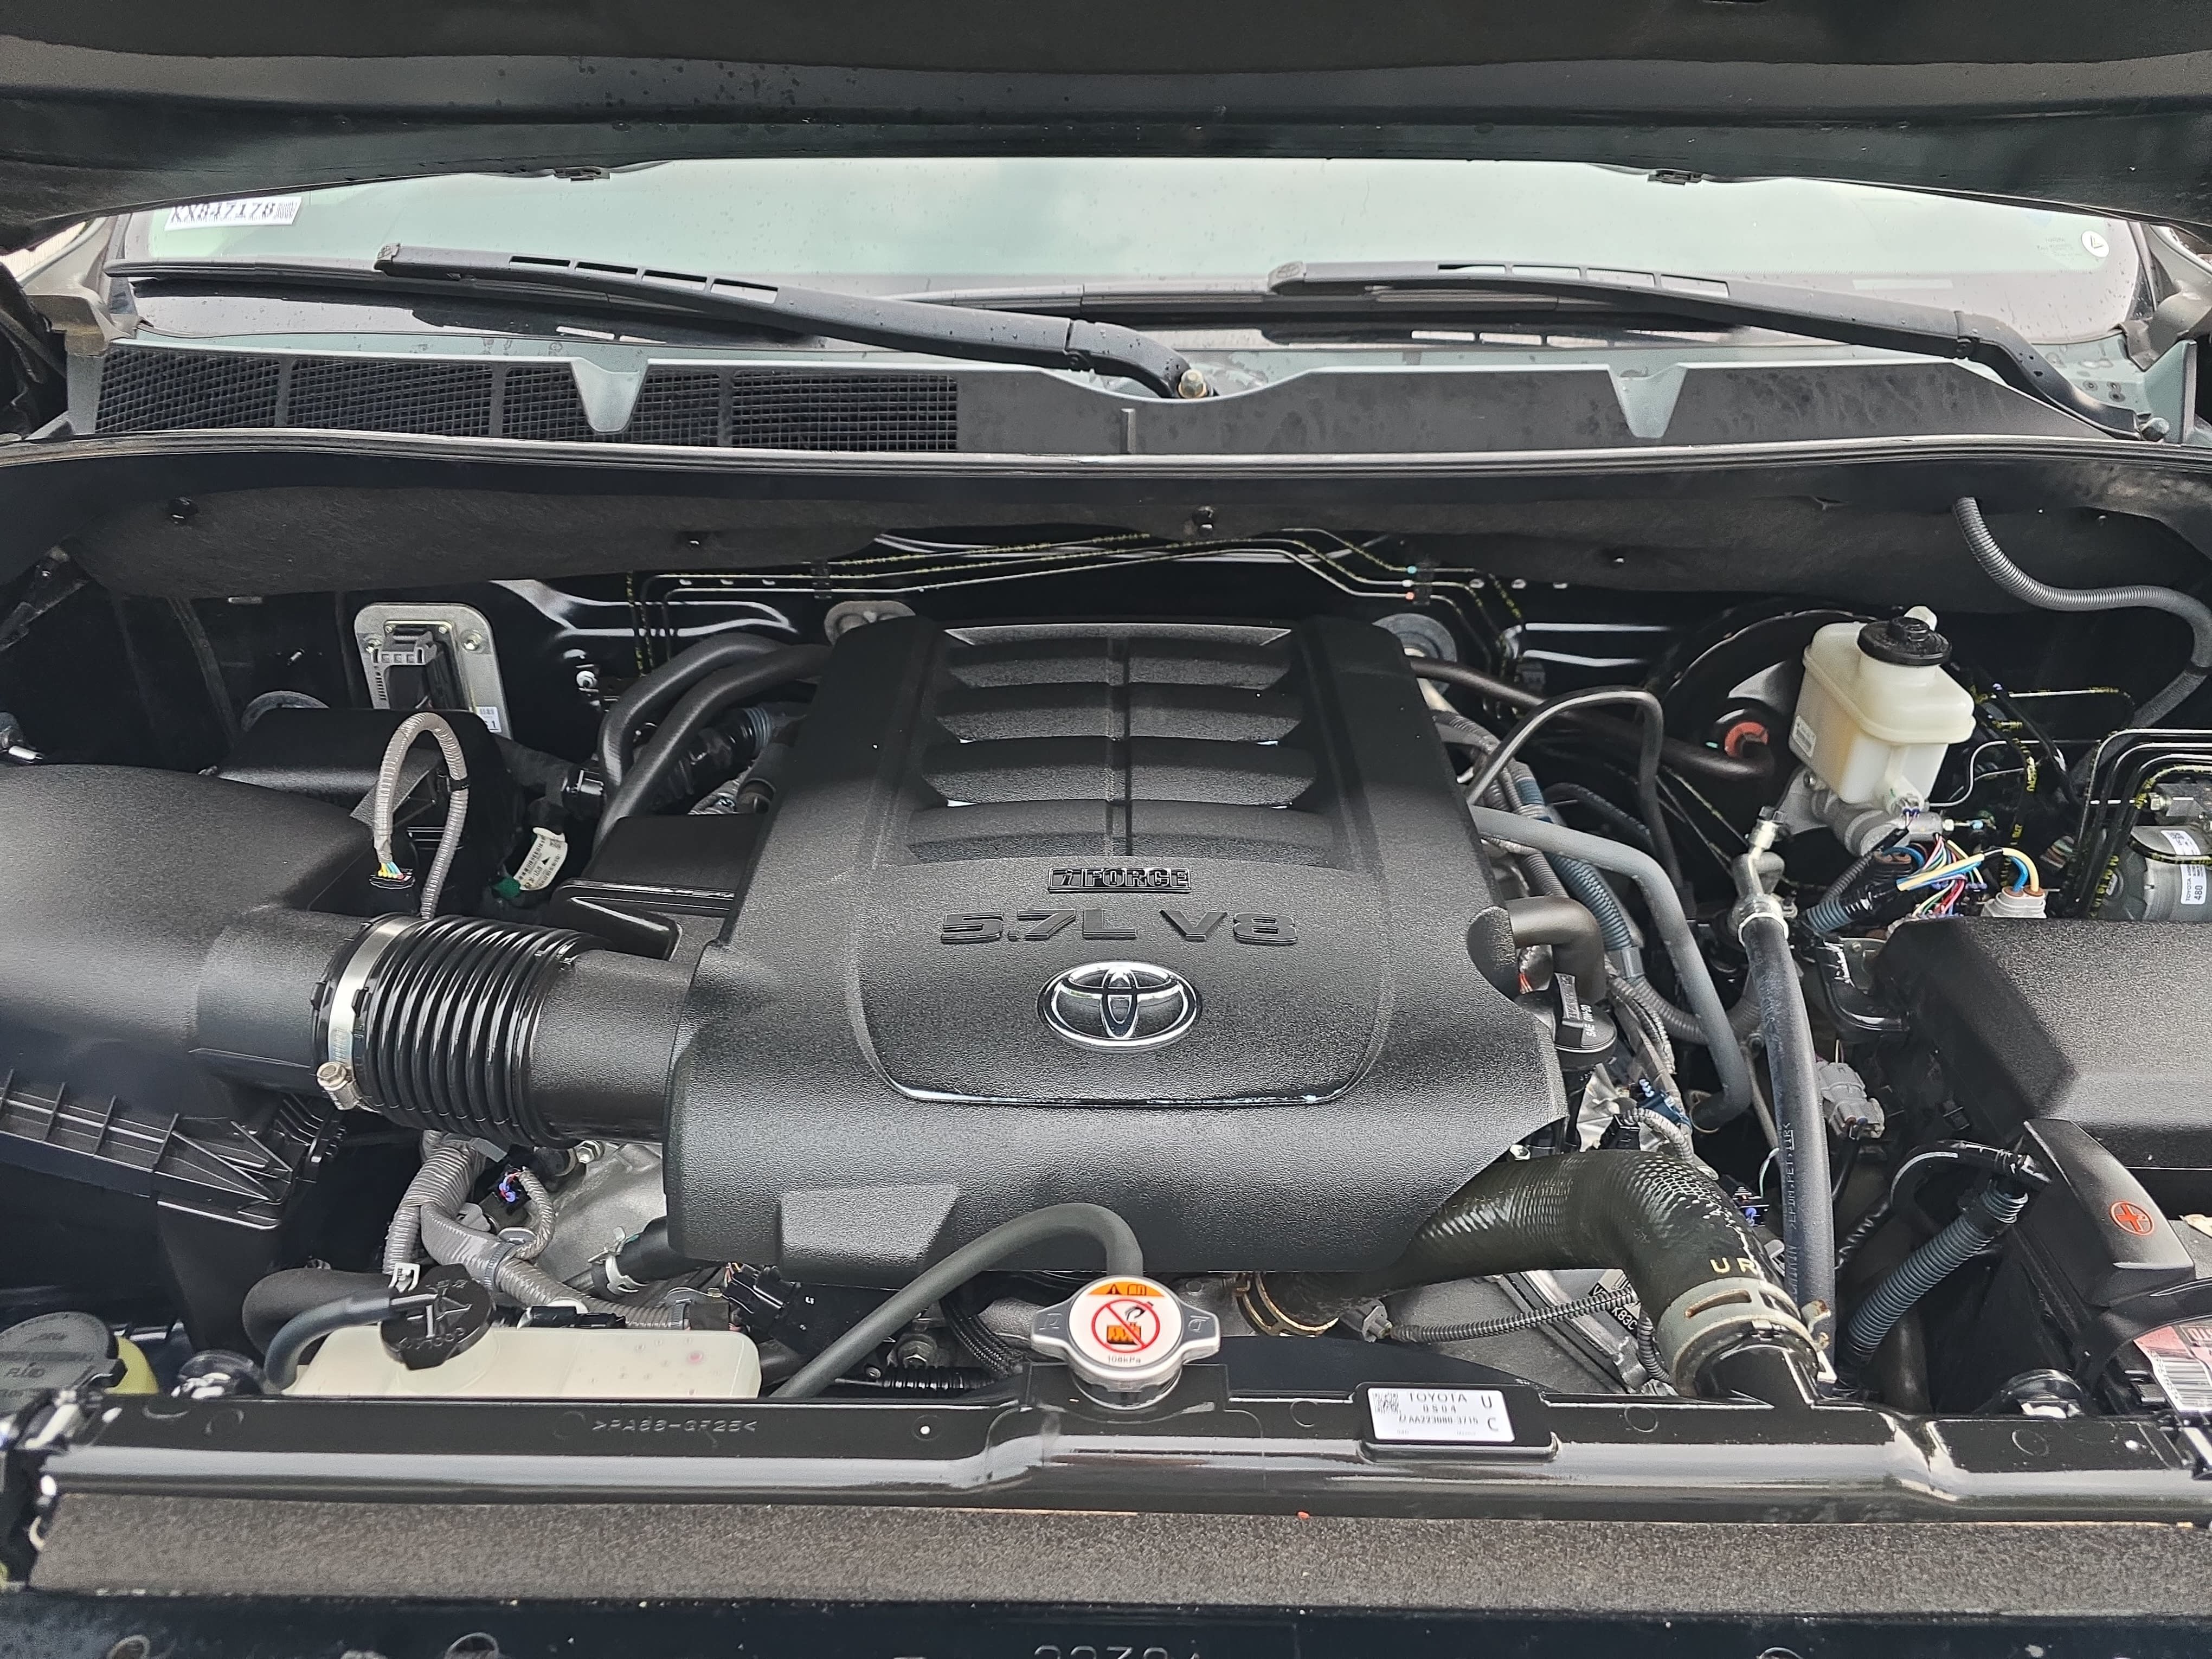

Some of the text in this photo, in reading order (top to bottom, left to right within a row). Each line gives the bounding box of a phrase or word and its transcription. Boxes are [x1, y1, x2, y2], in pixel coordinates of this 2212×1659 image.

[2194, 885, 2203, 901] 480
[941, 909, 1298, 946] 5.7L V8
[1584, 1023, 1596, 1037] SAE
[1409, 1392, 1468, 1403] TOYOTA
[1481, 1394, 1492, 1410] U
[1487, 1417, 1499, 1432] C
